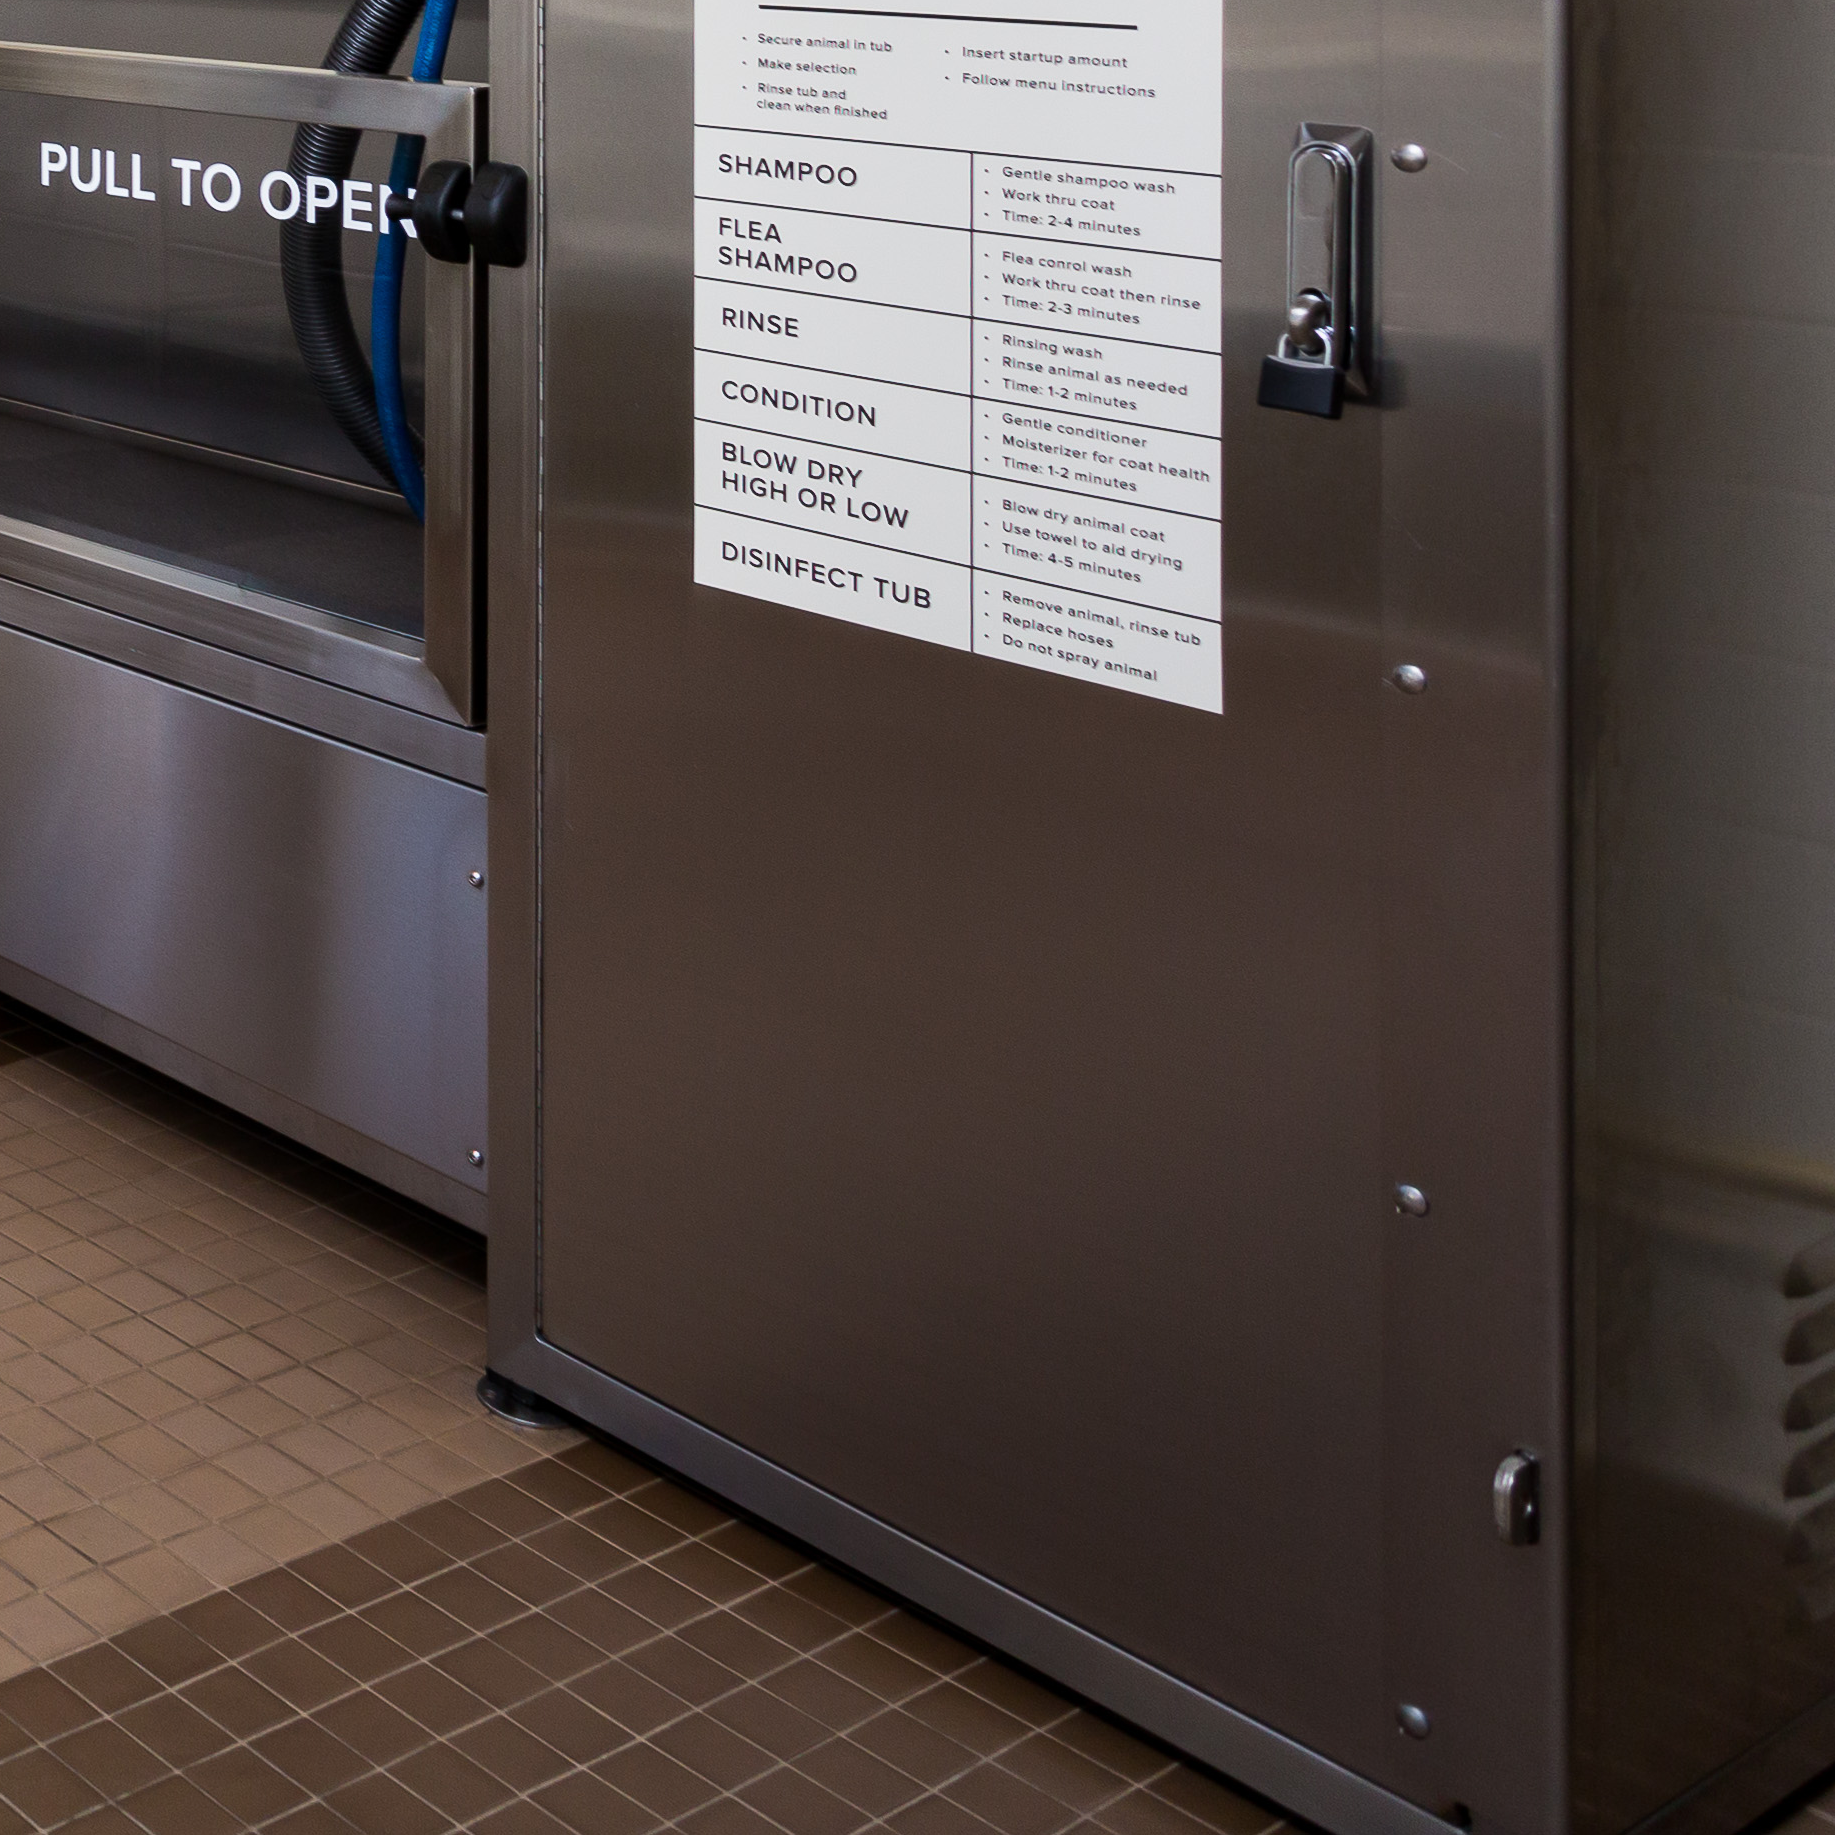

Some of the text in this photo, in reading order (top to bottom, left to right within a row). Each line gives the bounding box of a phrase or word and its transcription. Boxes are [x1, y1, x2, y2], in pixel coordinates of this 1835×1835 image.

[757, 33, 893, 52] Secure animal in tub
[962, 46, 1128, 68] Insert startup amount
[758, 57, 857, 75] Make selection
[757, 82, 847, 100] Rinse tub and
[962, 72, 1156, 98] Follow menu instructions
[756, 99, 888, 120] clean when finished
[40, 141, 157, 202] PULL
[170, 157, 242, 213] TO
[718, 153, 858, 187] SHAMPOO
[1002, 166, 1175, 194] Gentle shampoo wash
[1001, 187, 1115, 211] Work thru coat
[719, 216, 783, 244] FLEA
[1002, 209, 1141, 237] Time: 2-4 minutes
[718, 245, 858, 284] SHAMPOO
[1002, 250, 1034, 266] Flea
[1090, 264, 1132, 278] wash
[1002, 272, 1201, 310] Work thru coat then rinse
[722, 306, 799, 339] RINSE
[1001, 294, 1140, 325] Time: 2-3 minutes
[1002, 334, 1103, 360] Rinsing wash
[1002, 356, 1188, 396] Rinse animal as needed
[721, 380, 876, 428] CONDITION
[1002, 377, 1138, 411] Time: 1-2 minutes
[1002, 412, 1147, 448] Gentle conditioner
[722, 441, 863, 489] BLOW DRY
[1001, 455, 1137, 492] Time: 1-2 minutes
[1092, 450, 1115, 465] for
[1118, 458, 1154, 473] coat
[1158, 462, 1210, 483] health
[722, 469, 910, 529] HIGH OR LOW
[1002, 499, 1165, 543] Blow dry animal coat
[1001, 542, 1142, 583] Time: 4-5 minutes
[1002, 520, 1183, 572] Use towel to aid drying
[722, 540, 932, 609] DISINFECT TUB
[1002, 590, 1063, 615] Remove
[1129, 620, 1170, 639] rinse
[1174, 630, 1201, 646] tub
[1002, 611, 1114, 649] Replace hoses
[1002, 633, 1158, 682] Do not spray animal
